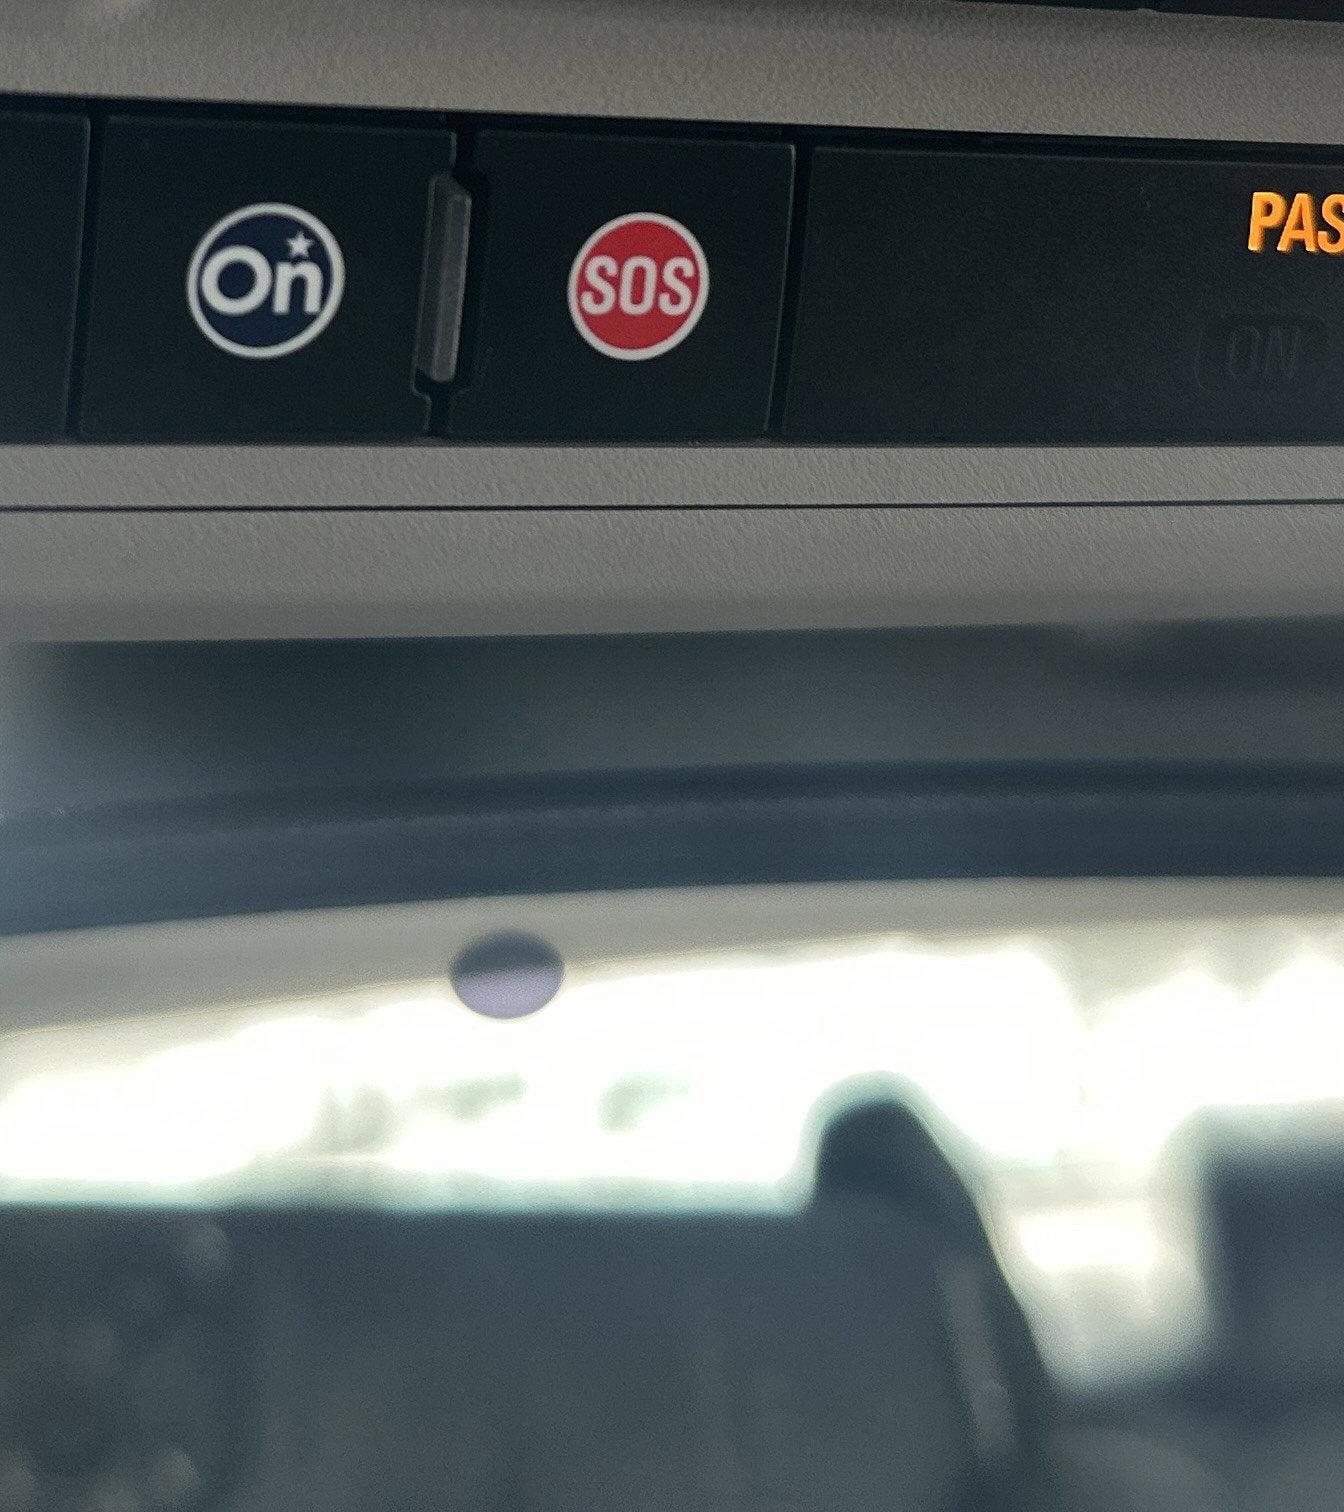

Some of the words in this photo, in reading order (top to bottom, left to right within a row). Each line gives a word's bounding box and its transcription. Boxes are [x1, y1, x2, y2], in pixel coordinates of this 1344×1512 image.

[201, 245, 323, 316] On
[579, 255, 696, 316] SOS
[1226, 325, 1302, 382] ON
